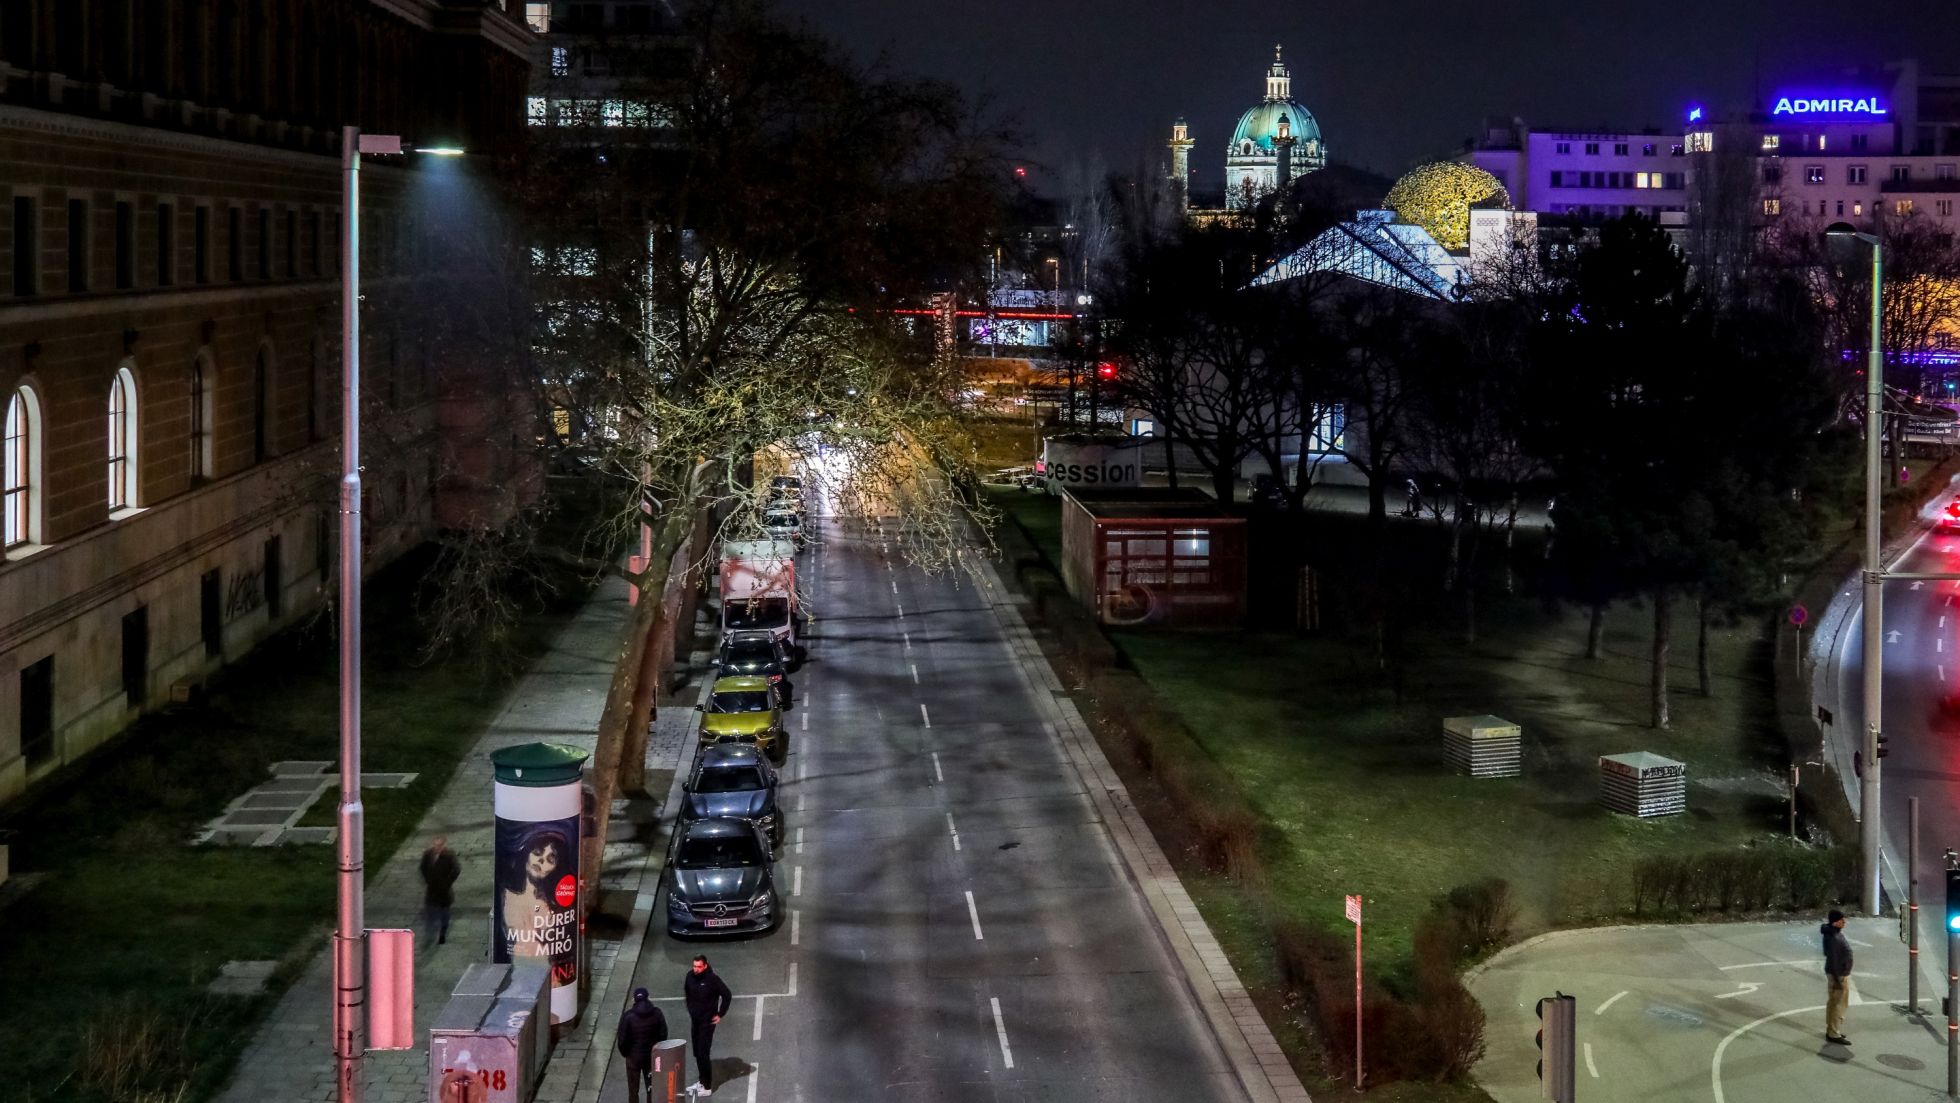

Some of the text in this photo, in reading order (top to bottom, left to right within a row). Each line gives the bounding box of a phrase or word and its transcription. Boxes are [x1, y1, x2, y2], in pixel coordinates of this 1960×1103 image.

[1773, 98, 1886, 114] ADMIRAL
[534, 909, 575, 929] DÜRER
[507, 927, 565, 943] MUNCH
[535, 934, 573, 956] MIRÓ
